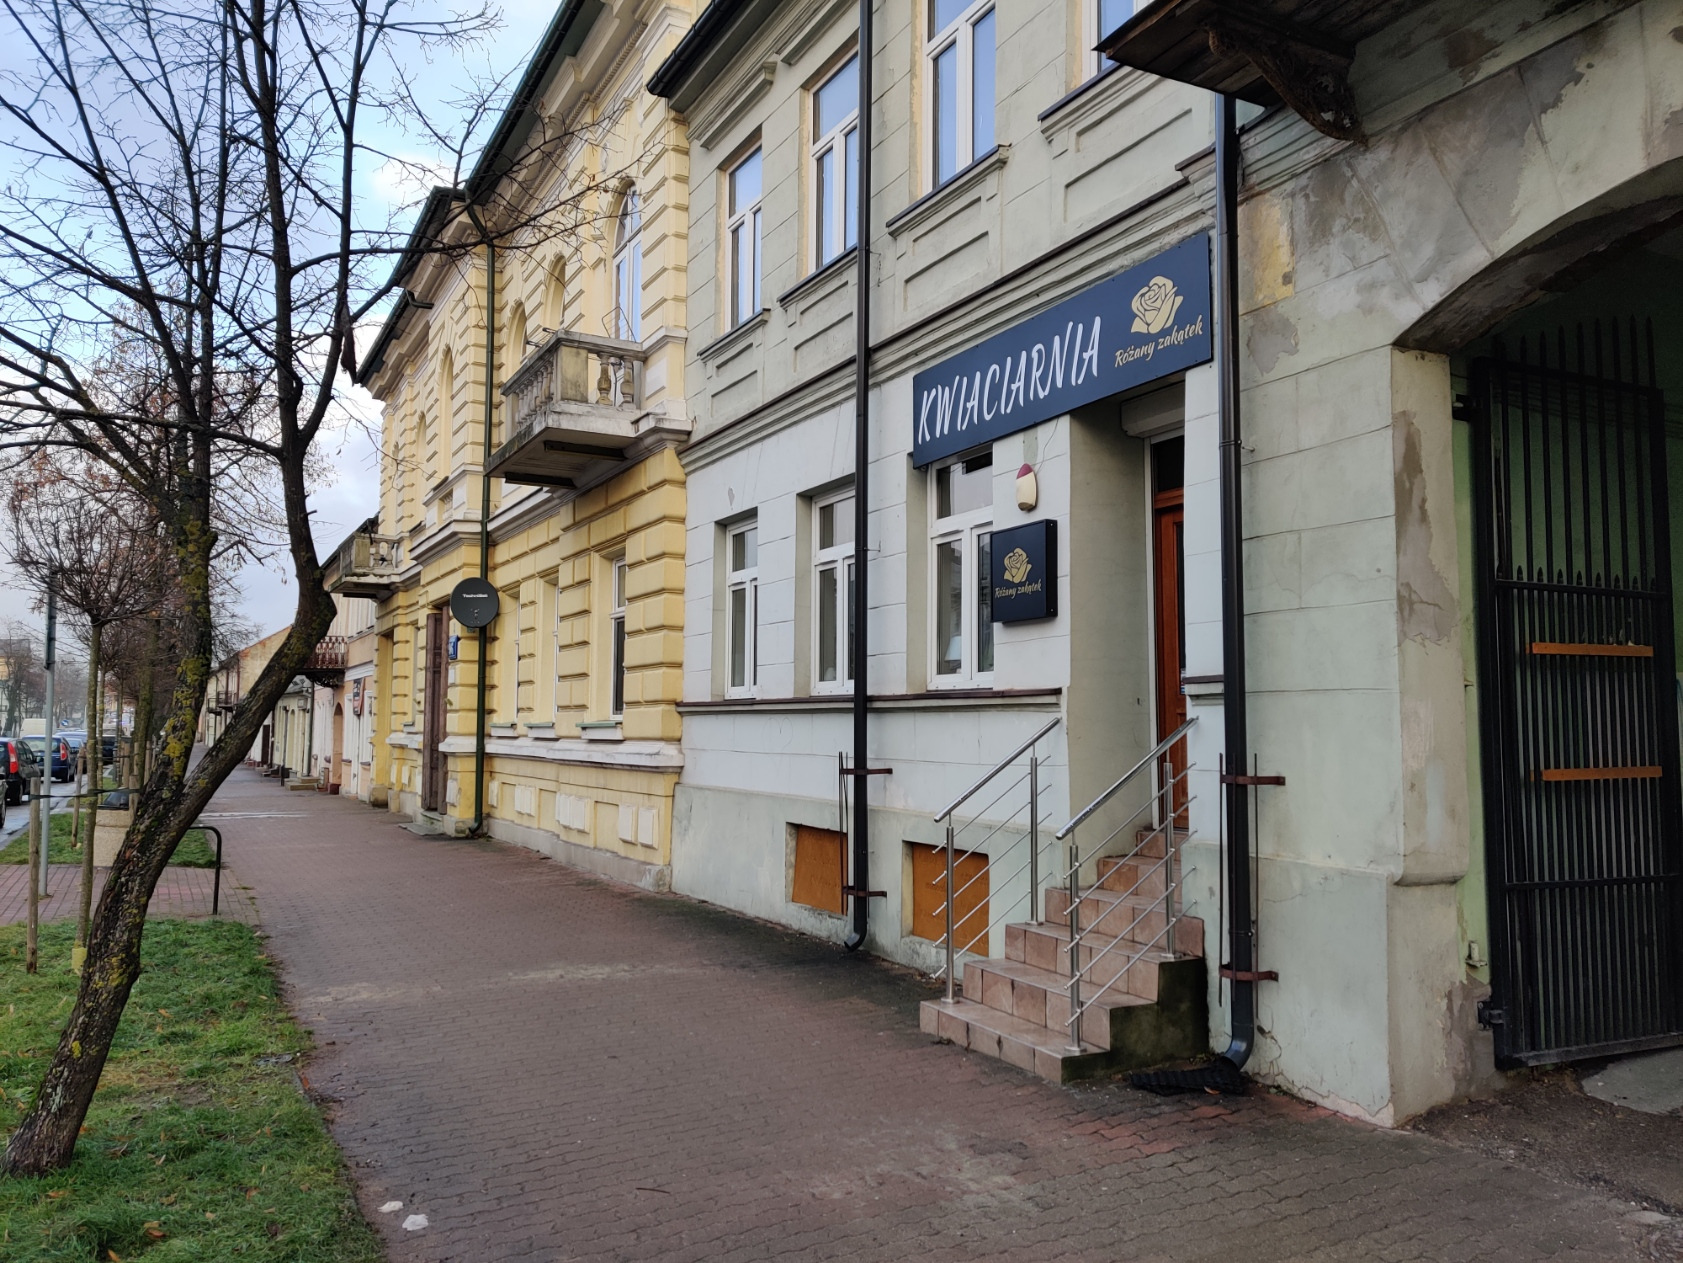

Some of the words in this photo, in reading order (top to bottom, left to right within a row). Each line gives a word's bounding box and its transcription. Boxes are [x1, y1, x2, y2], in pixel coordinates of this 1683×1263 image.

[1114, 340, 1156, 368] Różany
[1157, 314, 1204, 350] zakątek
[918, 315, 1102, 445] KWIACIARNIA
[994, 587, 1017, 599] Różany
[1017, 578, 1041, 594] zakątek
